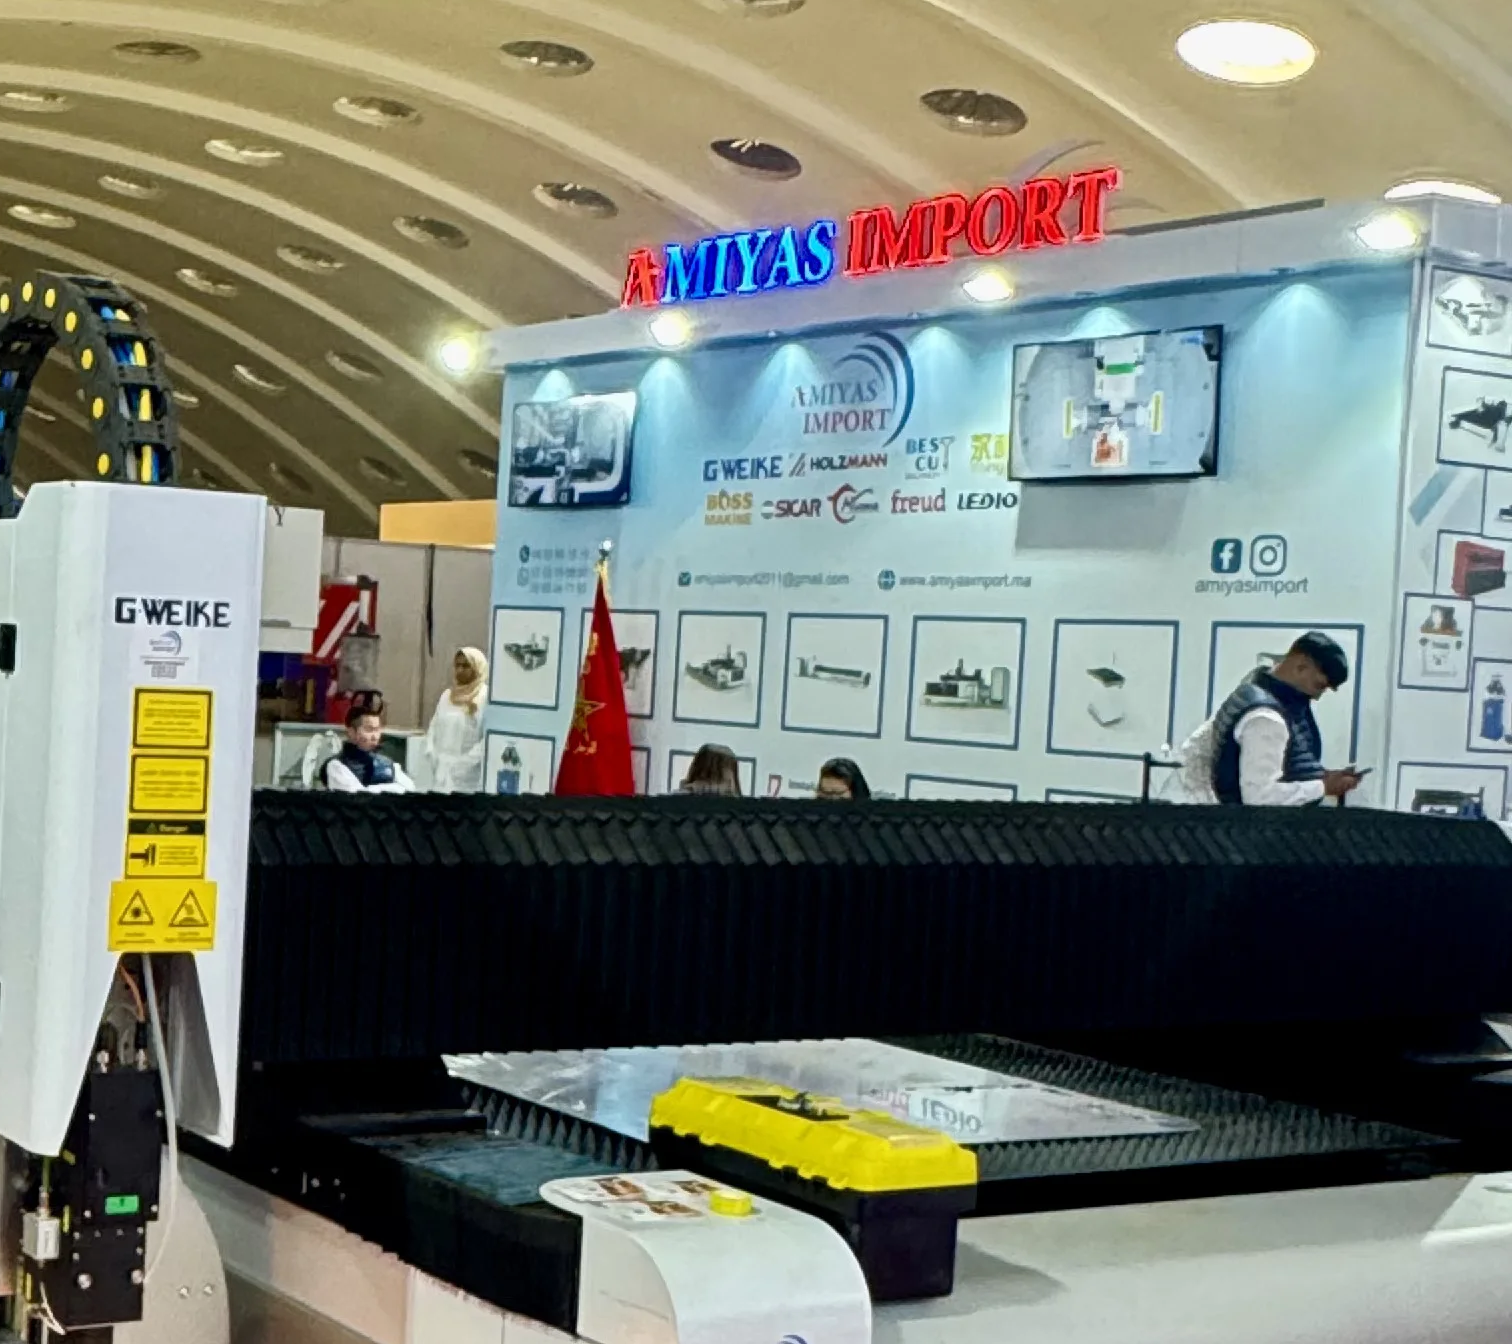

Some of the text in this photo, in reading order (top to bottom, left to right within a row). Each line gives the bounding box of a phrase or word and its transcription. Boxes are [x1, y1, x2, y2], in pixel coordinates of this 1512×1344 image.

[620, 165, 1124, 311] AMIYAS IMPORT
[790, 378, 880, 409] AMIYAS
[802, 407, 892, 435] IMPORT
[809, 452, 888, 472] HOLZMANN
[890, 486, 946, 514] freud
[1194, 577, 1309, 599] amiyasimport
